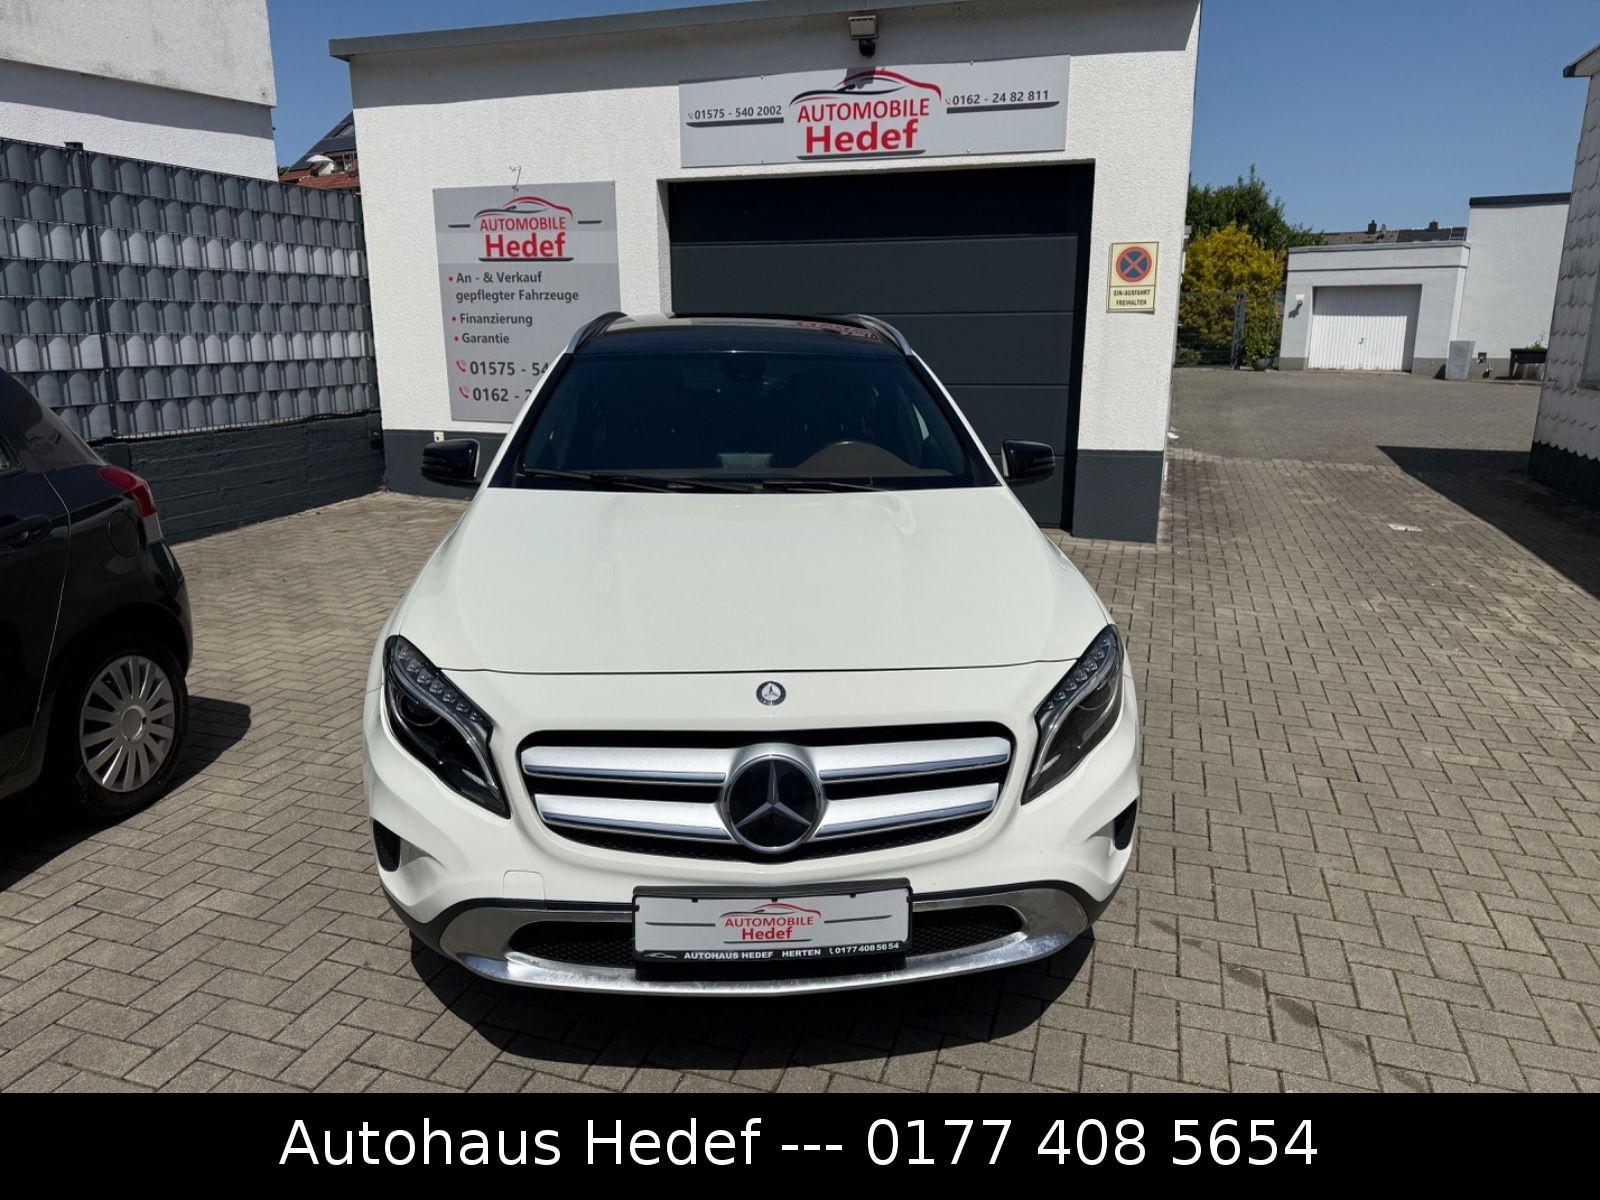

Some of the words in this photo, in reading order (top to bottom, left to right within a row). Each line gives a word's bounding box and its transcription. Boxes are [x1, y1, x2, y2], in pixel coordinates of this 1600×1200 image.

[952, 93, 980, 106] 0162
[992, 92, 1007, 104] 24
[1009, 91, 1024, 103] 82
[1027, 90, 1049, 102] 811
[694, 107, 725, 121] 01575
[735, 106, 755, 119] 540
[757, 105, 782, 118] 2002
[797, 98, 930, 123] AUTOMOBILE
[805, 118, 919, 154] Hedef
[480, 216, 566, 232] AUTOMOBILE
[485, 232, 566, 258] Hedef
[456, 272, 472, 283] An
[483, 272, 494, 284] &
[497, 271, 542, 283] Verkauf
[456, 290, 516, 303] gepflegter
[519, 289, 579, 304] Fahrzeuge
[460, 313, 533, 326] Finanzierung
[462, 332, 510, 344] Garantie
[469, 361, 516, 376] 01575
[472, 388, 509, 402] 0162
[724, 915, 814, 928] AUTOMOBILE
[742, 927, 793, 941] Hedef
[684, 951, 739, 960] AUTOHAUS
[741, 951, 774, 959] HEDEF
[782, 949, 821, 958] HERTEN
